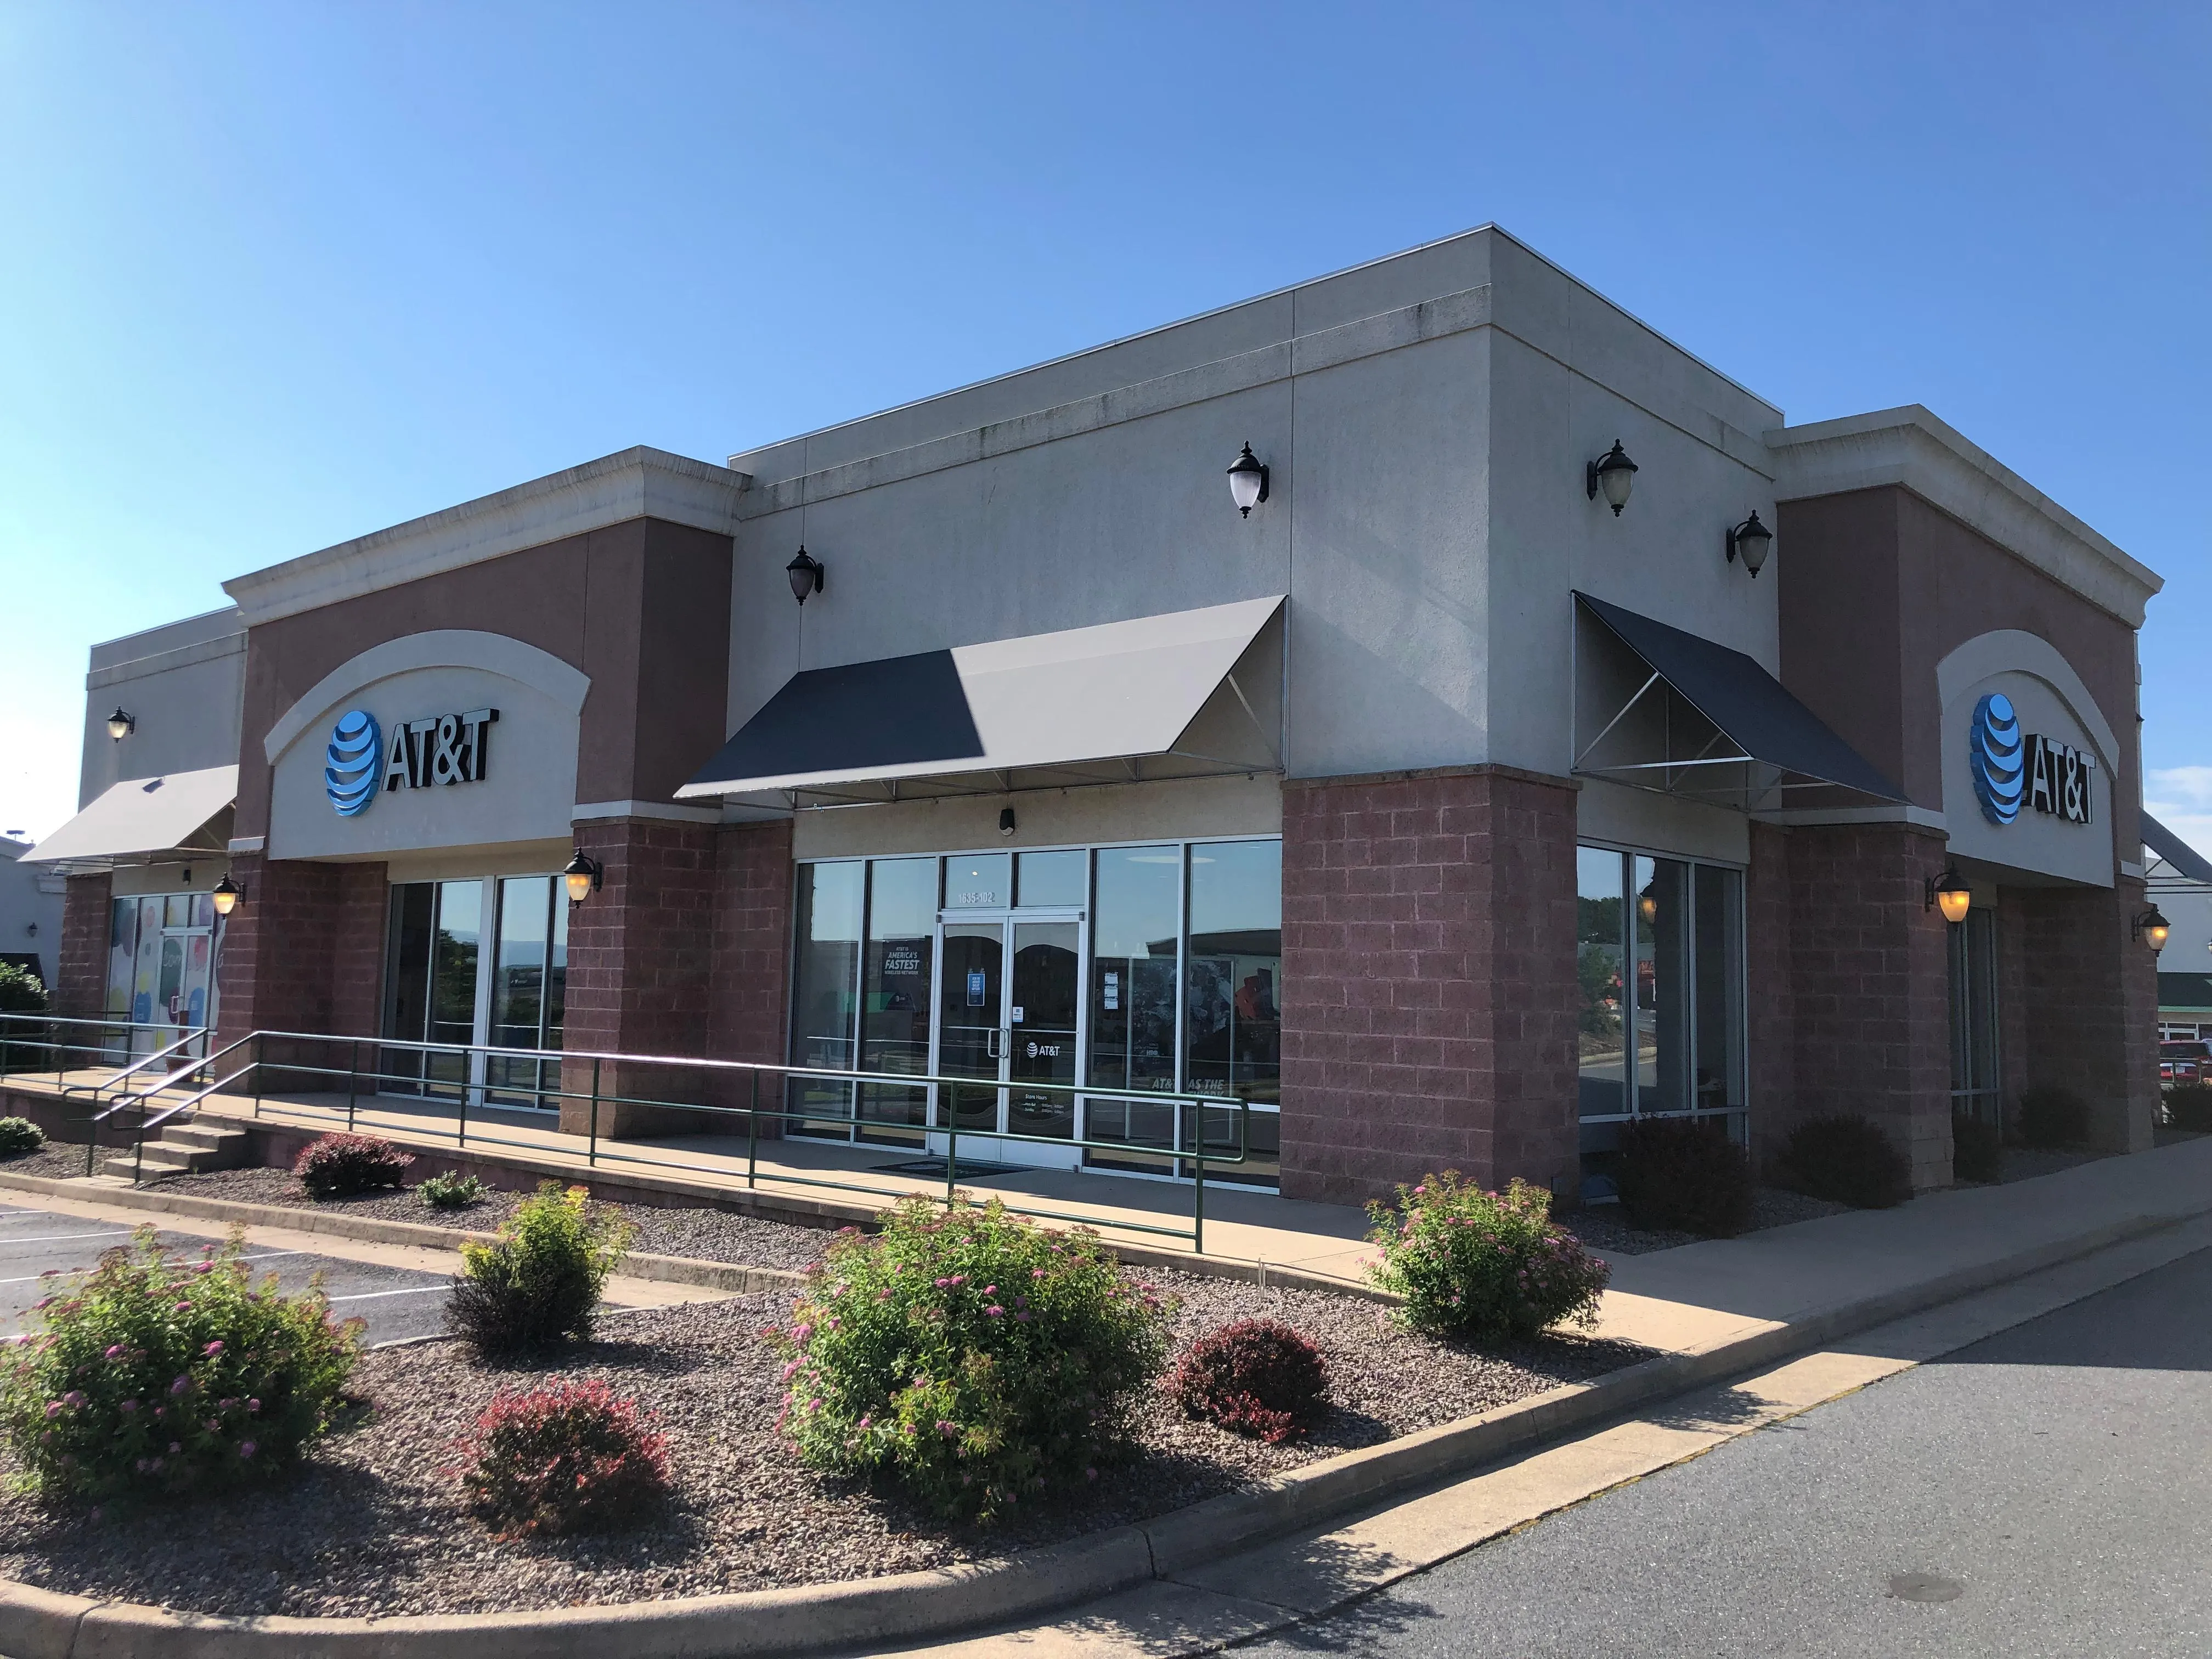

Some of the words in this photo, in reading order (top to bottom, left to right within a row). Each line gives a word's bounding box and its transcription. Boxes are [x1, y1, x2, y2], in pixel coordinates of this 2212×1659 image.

[382, 708, 499, 791] AT&T
[2024, 733, 2096, 824] AT&T
[958, 891, 994, 903] 1635-102
[885, 959, 920, 970] FASTEST
[1039, 1045, 1060, 1057] AT&T
[1204, 1079, 1224, 1090] THE
